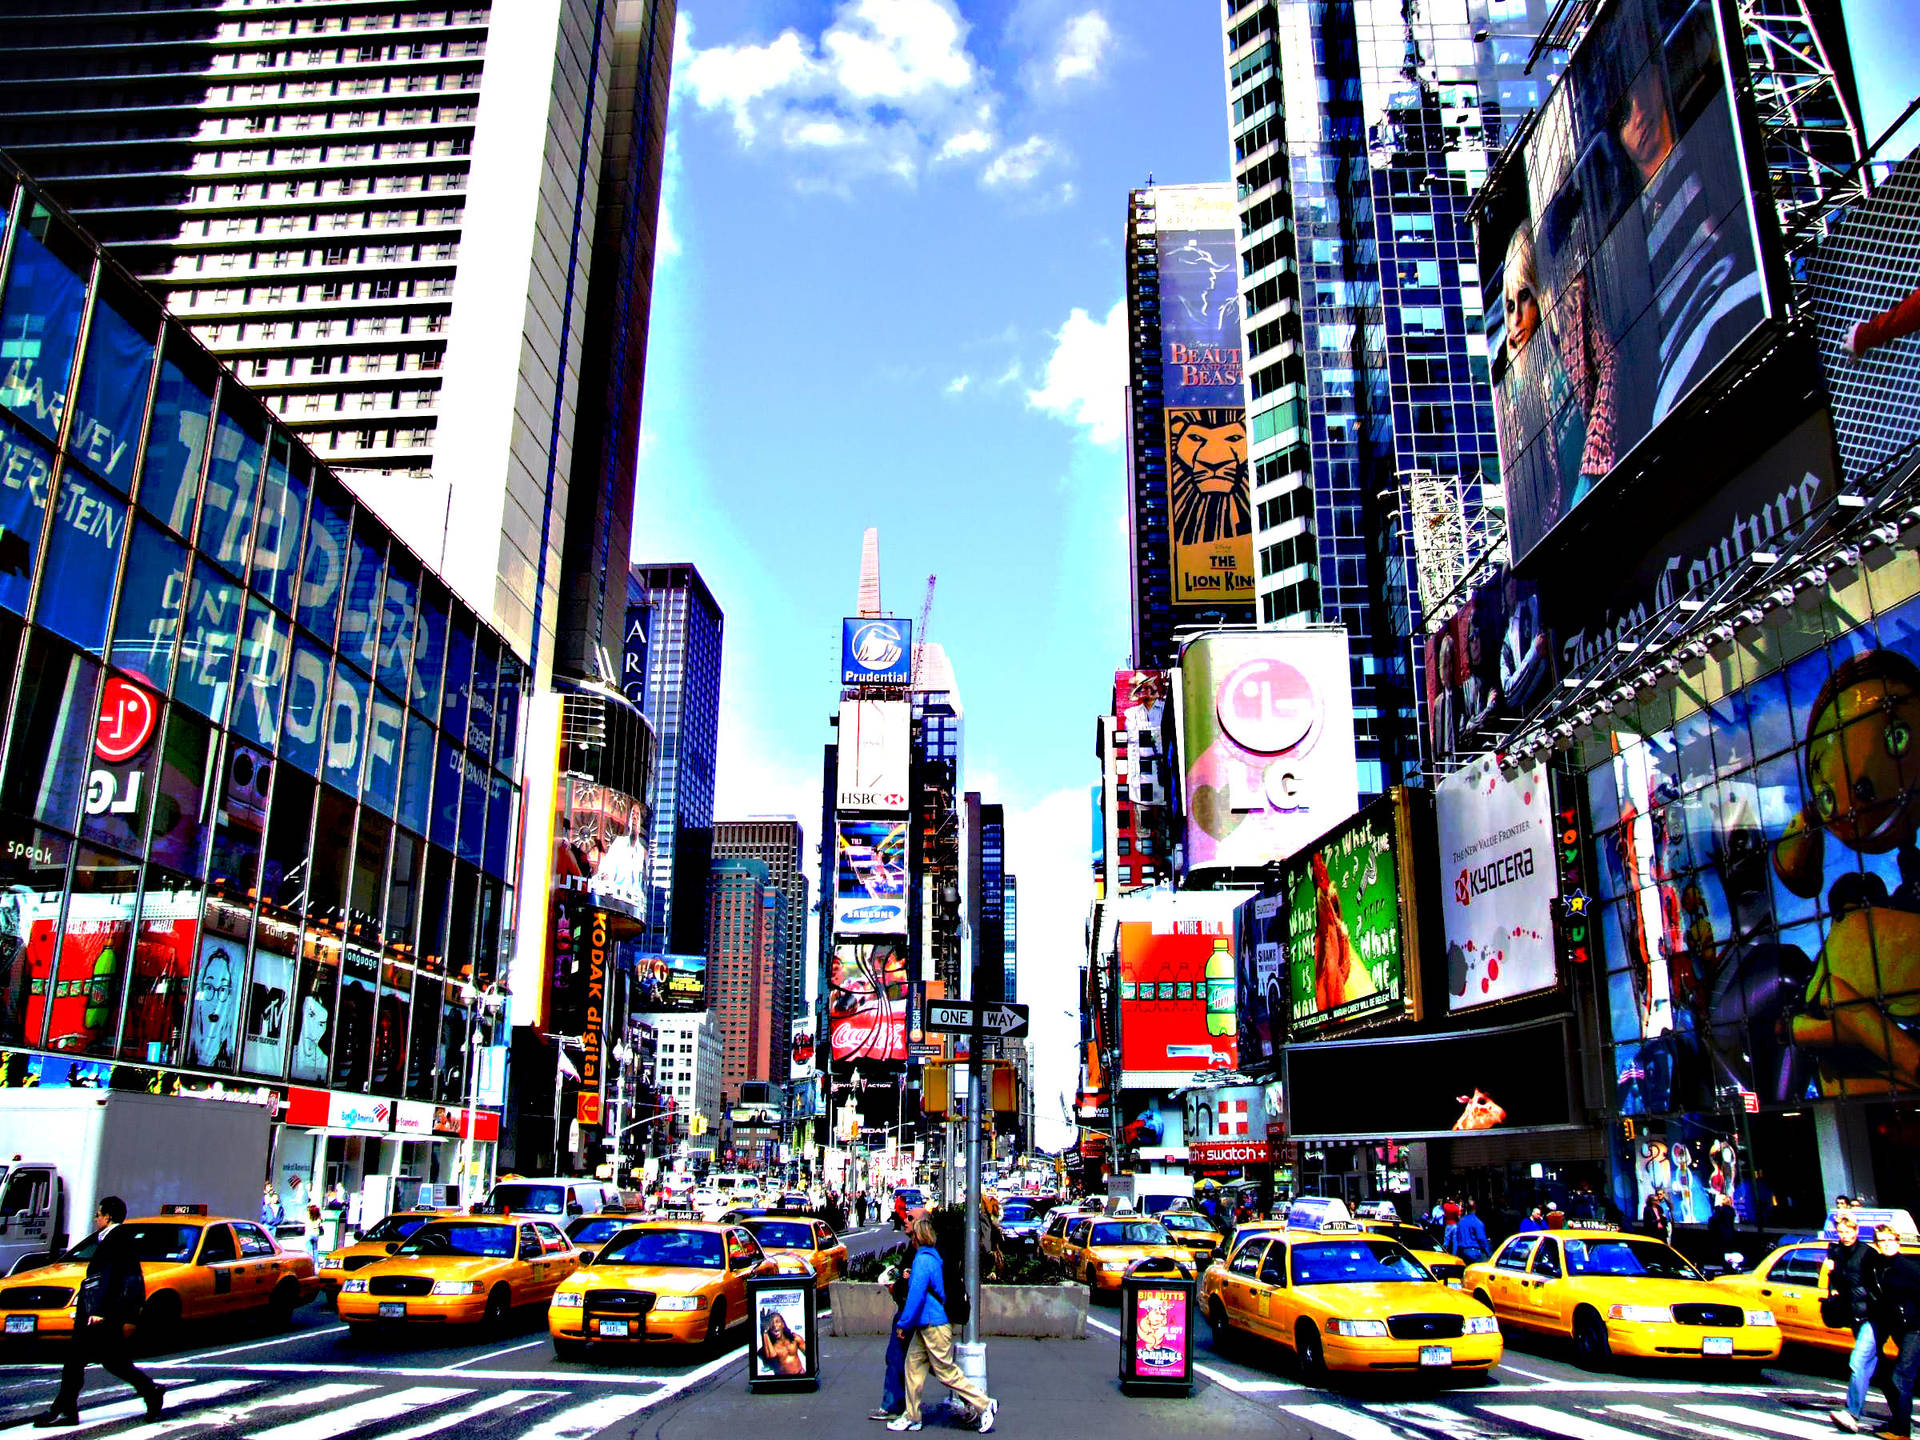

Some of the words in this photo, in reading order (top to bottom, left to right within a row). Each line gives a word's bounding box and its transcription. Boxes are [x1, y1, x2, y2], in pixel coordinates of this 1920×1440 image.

[1170, 343, 1240, 365] BEAUT
[1209, 555, 1236, 567] THE
[1184, 572, 1220, 592] LION
[161, 568, 228, 626] ON
[845, 670, 907, 684] Prudential
[231, 616, 403, 792] ROOF
[1229, 757, 1311, 814] LG
[841, 792, 882, 805] HSBC
[7, 840, 52, 864] speak
[1452, 852, 1465, 864] THE
[1464, 844, 1479, 859] NEW
[1478, 835, 1498, 851] VALUE
[1498, 820, 1531, 845] FRONTIER
[264, 925, 288, 940] same
[345, 951, 377, 971] language
[587, 912, 607, 999] KODAK
[940, 1010, 968, 1024] ONE
[987, 1012, 1016, 1027] WAY
[582, 1006, 603, 1087] digital
[1207, 1147, 1256, 1161] swatch
[1155, 1291, 1184, 1301] BUTTS
